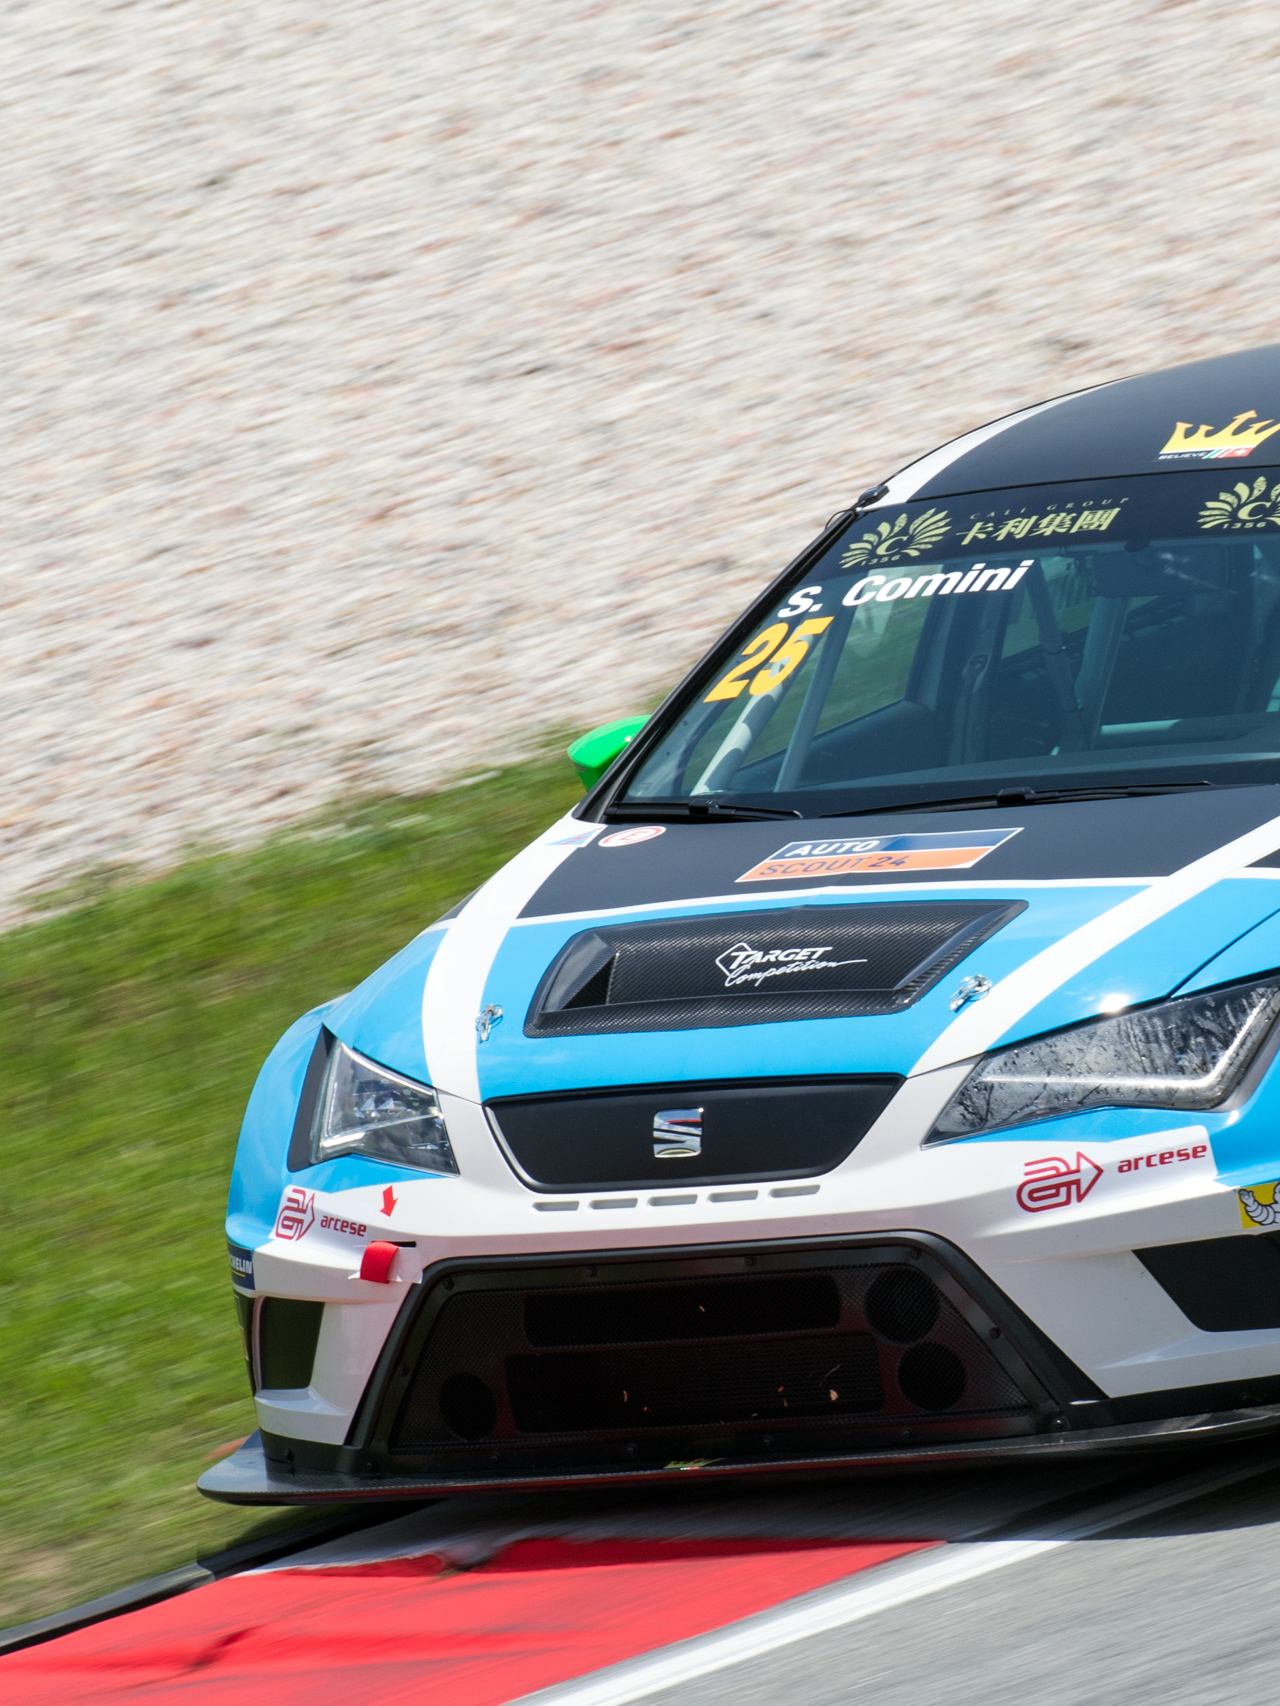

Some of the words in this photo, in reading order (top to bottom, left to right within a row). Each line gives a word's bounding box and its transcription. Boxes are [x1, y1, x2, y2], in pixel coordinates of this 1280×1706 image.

[1157, 451, 1208, 460] BELIEVE
[969, 506, 1028, 520] CALI
[1047, 497, 1130, 511] GROUP
[955, 507, 1121, 546] 卡利集團
[1222, 521, 1267, 529] 1356
[861, 554, 900, 566] 1356
[777, 586, 823, 618] S.
[842, 559, 1035, 607] Comini
[703, 616, 834, 703] 25
[784, 840, 880, 858] AUTO
[729, 946, 834, 970] TARGET
[724, 959, 868, 987] Competition
[1118, 1145, 1207, 1173] arcese
[320, 1215, 367, 1238] arcese
